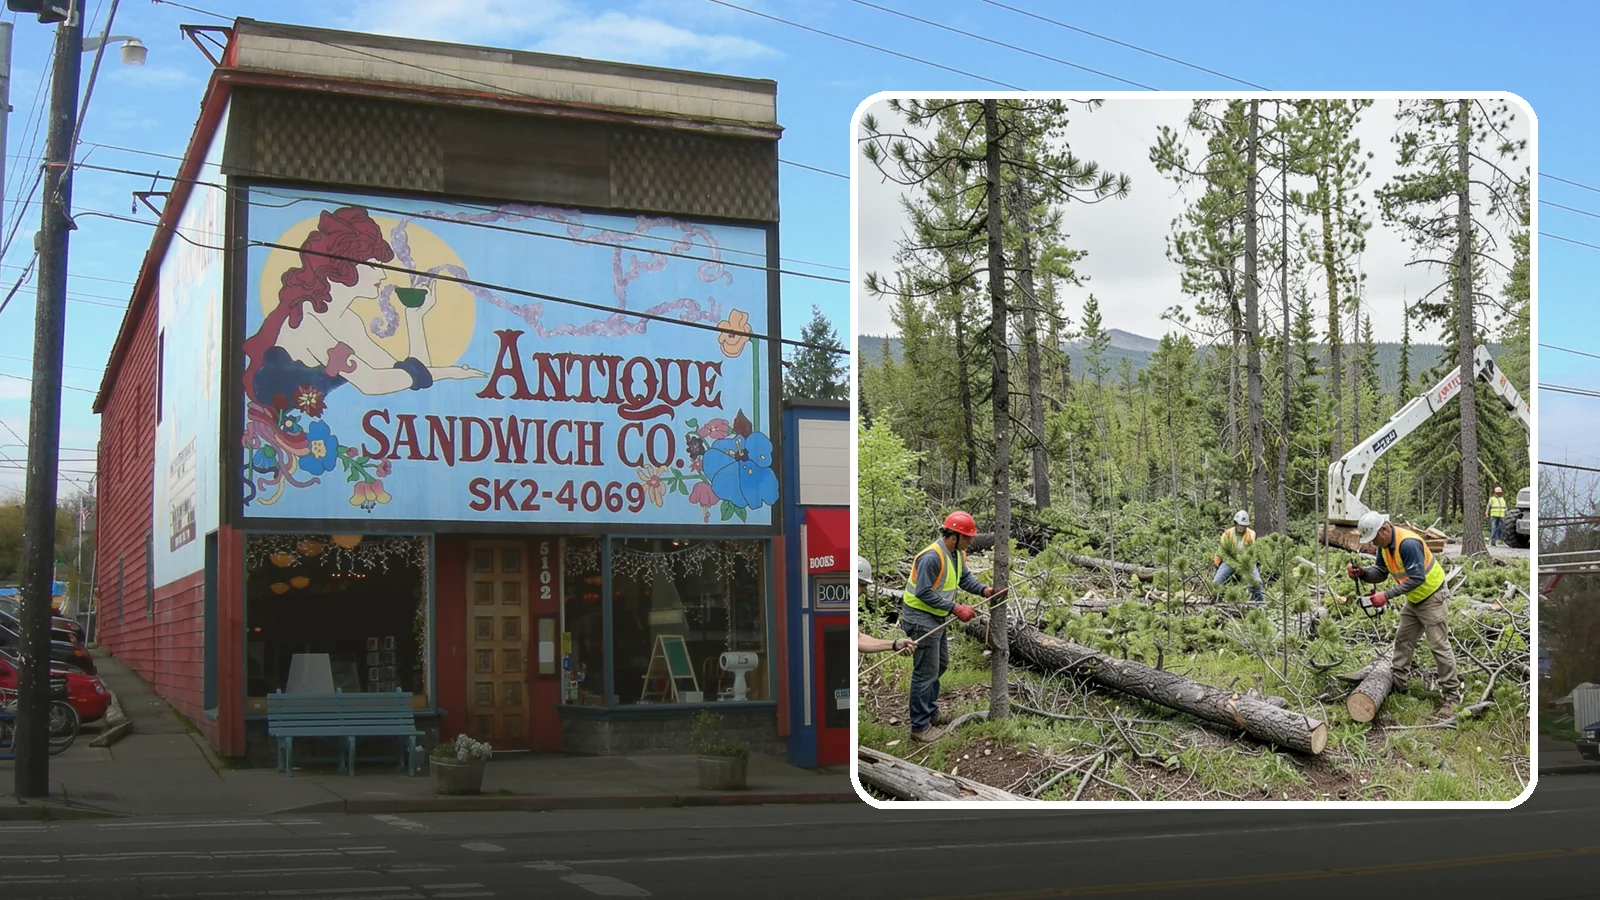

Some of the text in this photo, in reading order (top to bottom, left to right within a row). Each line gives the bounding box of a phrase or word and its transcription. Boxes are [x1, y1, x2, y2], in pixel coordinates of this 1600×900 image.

[361, 408, 684, 469] SANDWICH CO.
[468, 477, 646, 514] SK2-4069
[540, 541, 551, 600] 5102
[809, 555, 835, 569] BOOKS
